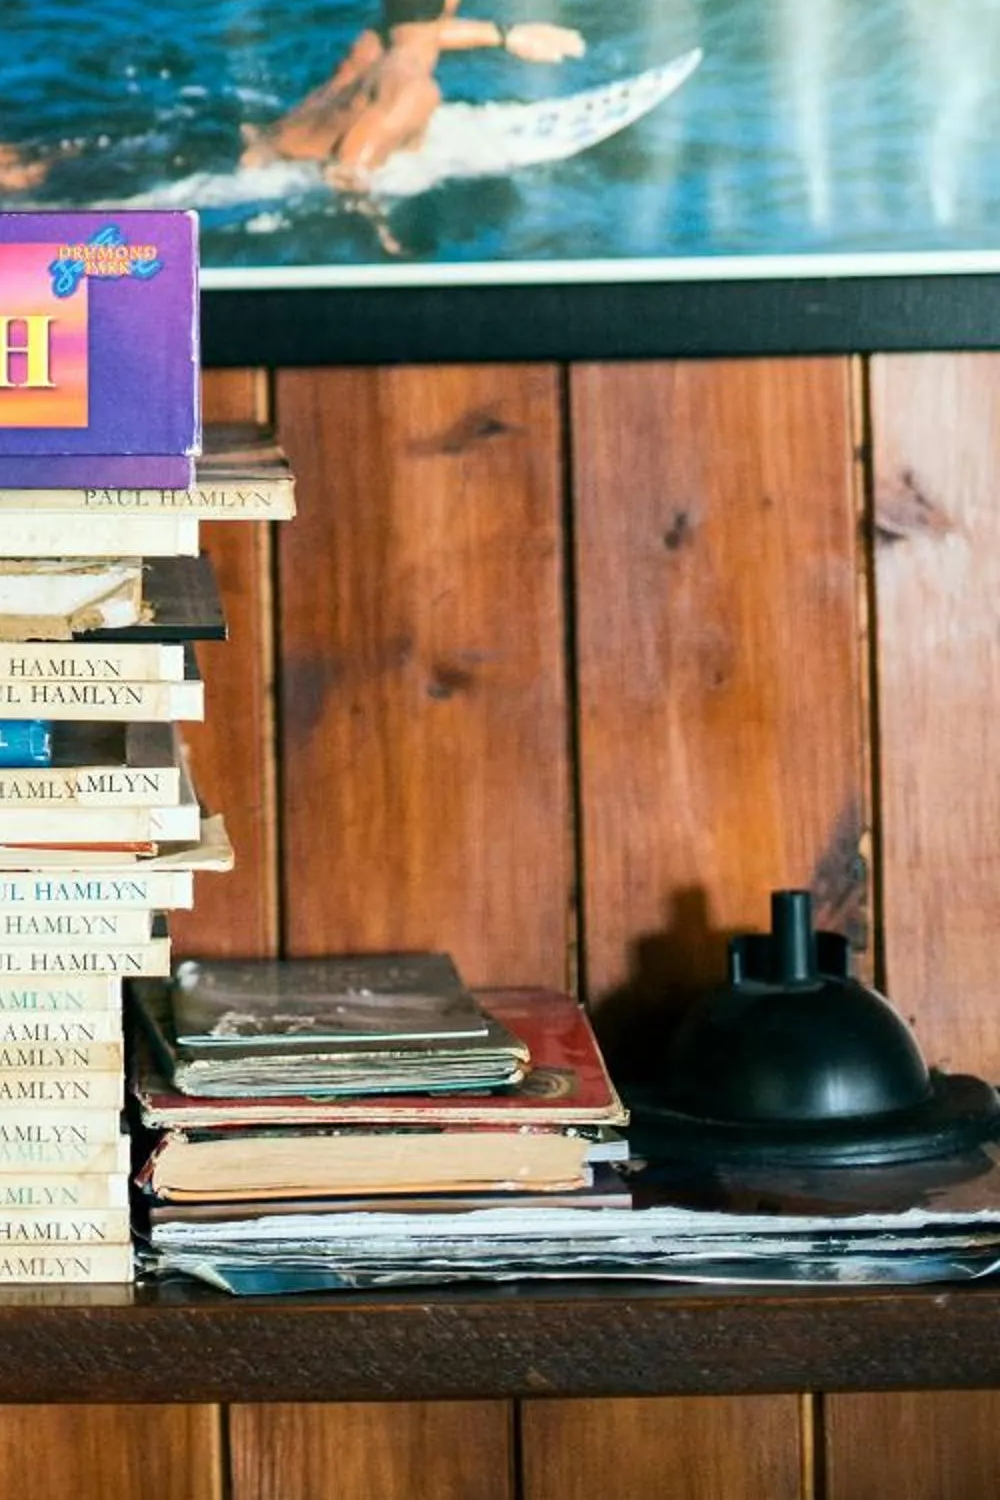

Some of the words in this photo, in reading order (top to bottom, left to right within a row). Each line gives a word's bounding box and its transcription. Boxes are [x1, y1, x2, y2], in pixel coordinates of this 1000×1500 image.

[85, 489, 150, 507] PAUL
[160, 488, 272, 507] HAMLYN
[10, 658, 122, 678] HAMLYN
[31, 684, 144, 705] HAMLYN
[34, 881, 148, 901] HAMLYN
[4, 915, 118, 935] HAMLYN
[30, 952, 144, 972] HAMLYN
